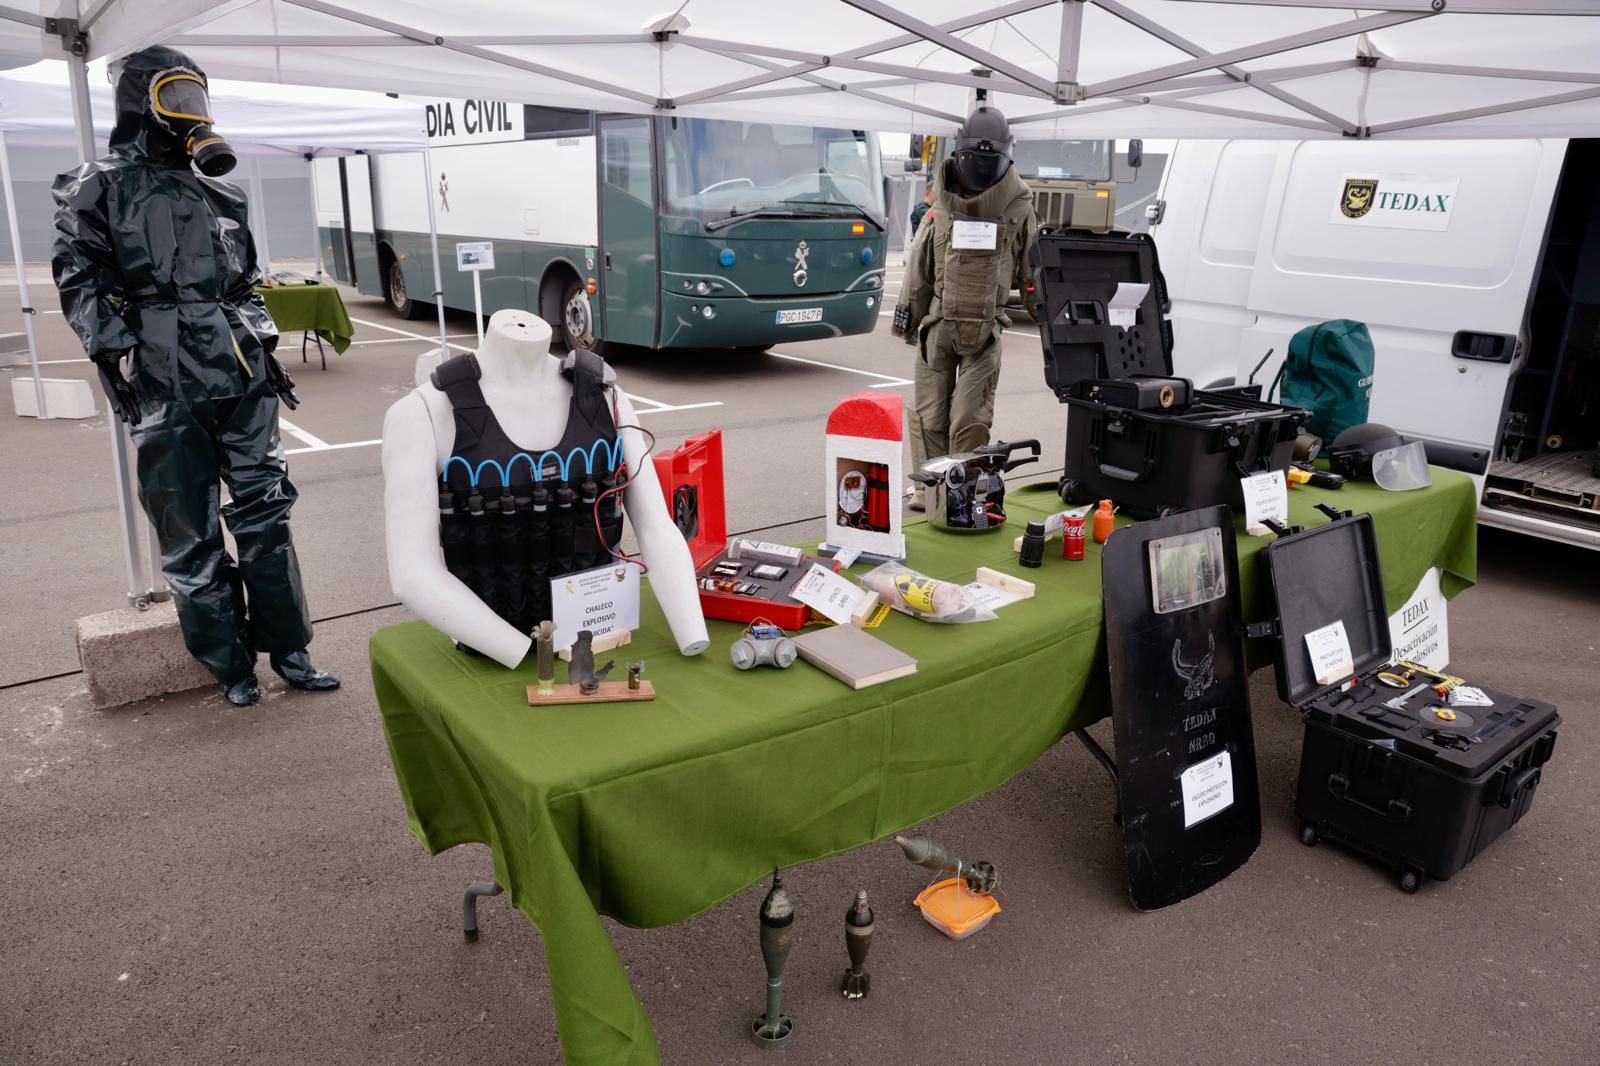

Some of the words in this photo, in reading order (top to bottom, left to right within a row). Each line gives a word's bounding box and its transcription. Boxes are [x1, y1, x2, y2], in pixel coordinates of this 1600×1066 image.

[464, 99, 512, 134] CIVIL
[1379, 192, 1450, 212] TEDAX
[586, 601, 614, 614] CHALECO
[1402, 597, 1430, 627] TEDAX
[582, 612, 616, 628] EXPLOSIVO
[1393, 622, 1438, 662] Desactivación
[1404, 640, 1438, 663] plosivos
[1183, 707, 1217, 732] TEDAX
[1188, 732, 1216, 753] NRBQ
